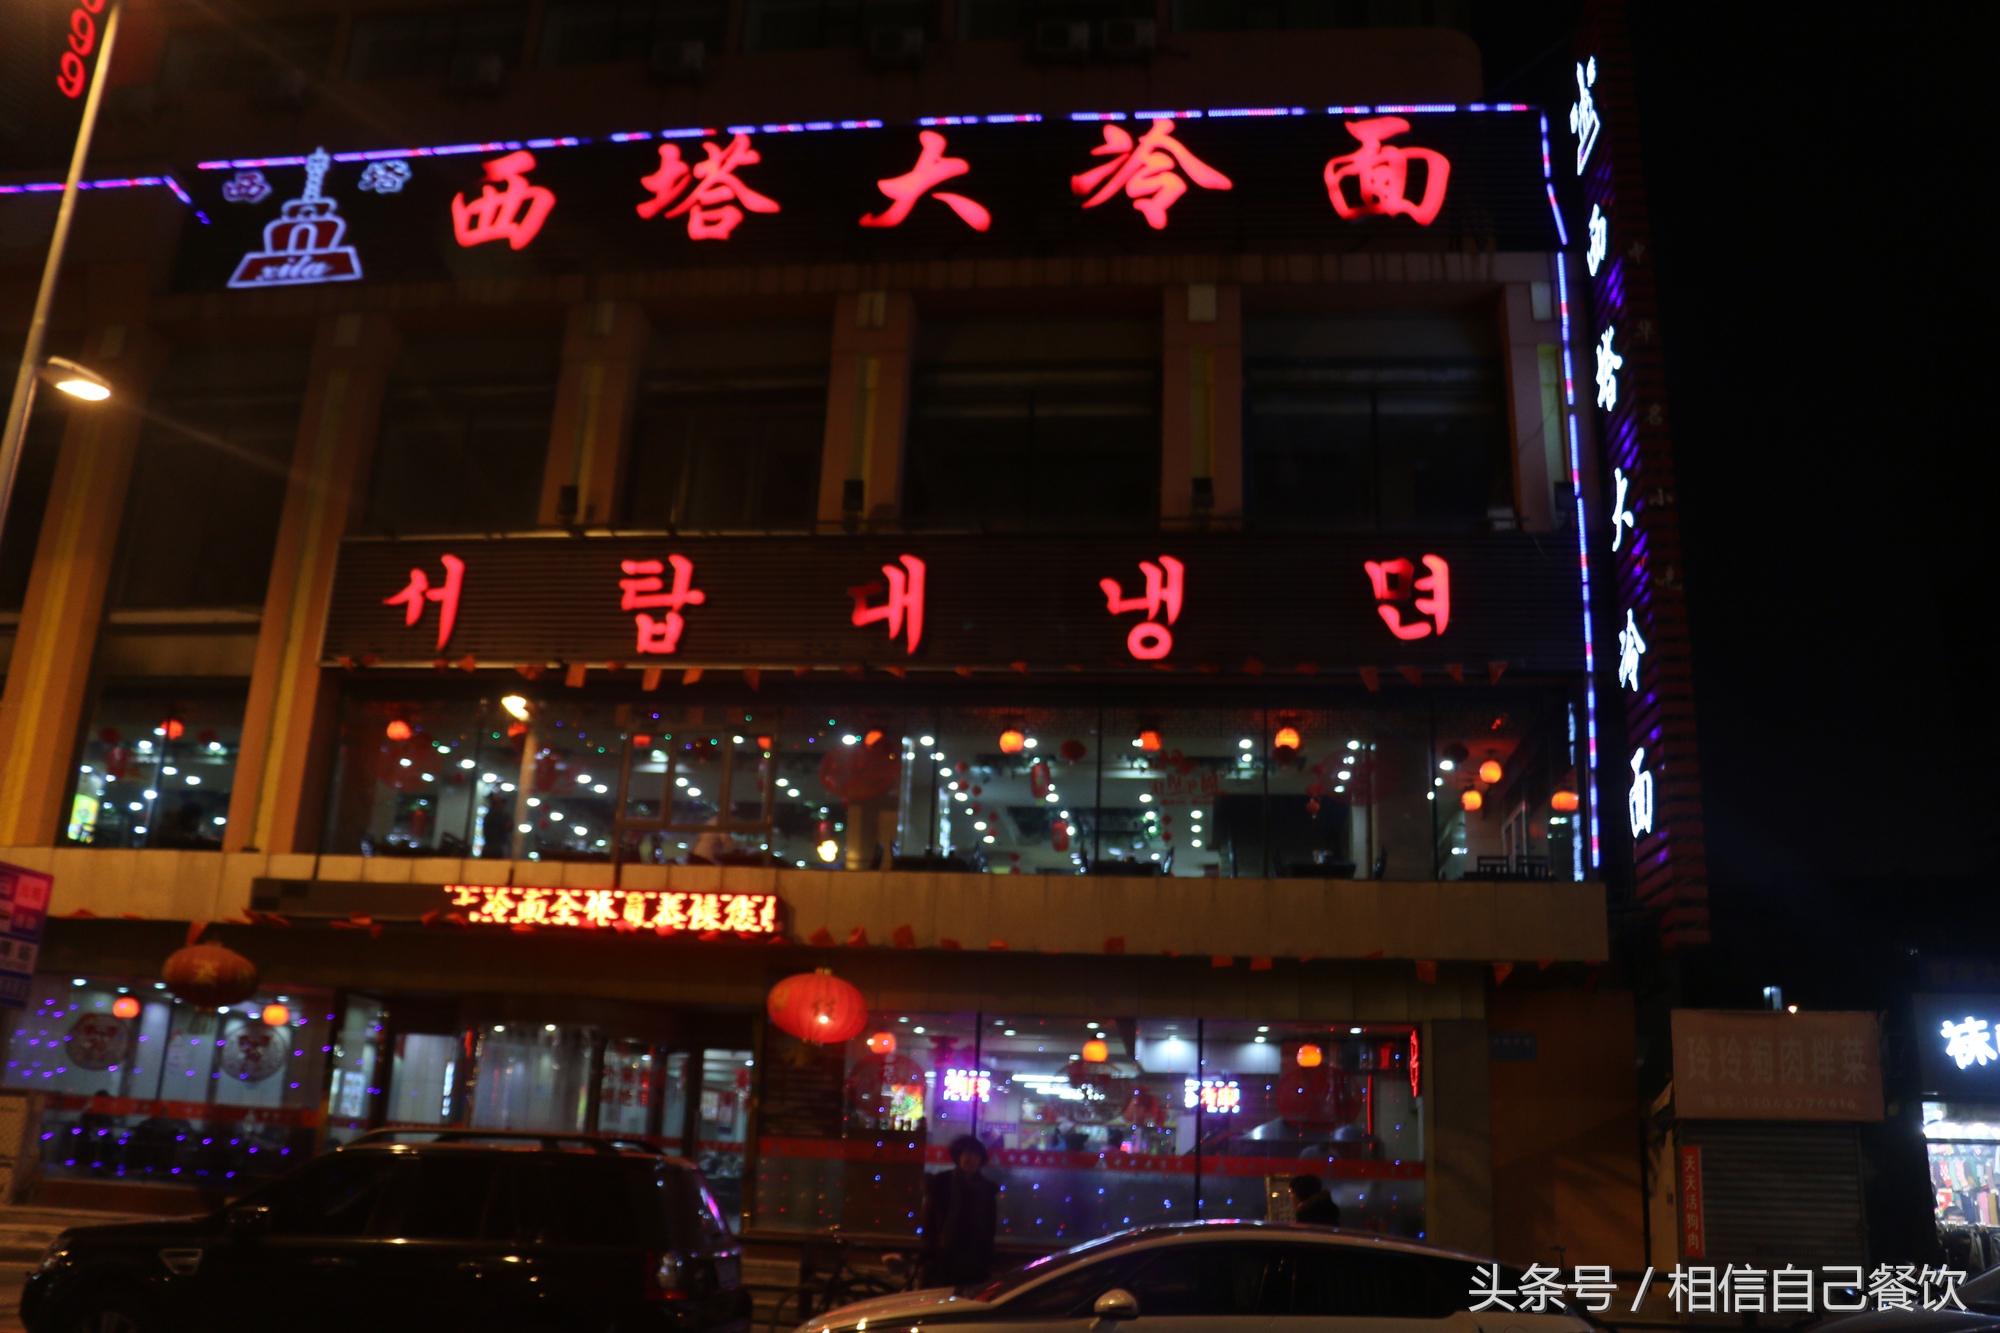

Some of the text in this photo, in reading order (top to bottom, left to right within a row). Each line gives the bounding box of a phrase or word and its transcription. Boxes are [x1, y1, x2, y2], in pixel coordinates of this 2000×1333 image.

[452, 117, 1450, 250] 西塔大冷面
[1686, 1035, 1868, 1085] 玲玲狗肉拌菜
[1940, 1016, 2000, 1070] 袜
[1684, 1154, 1700, 1251] 天天活狗肉
